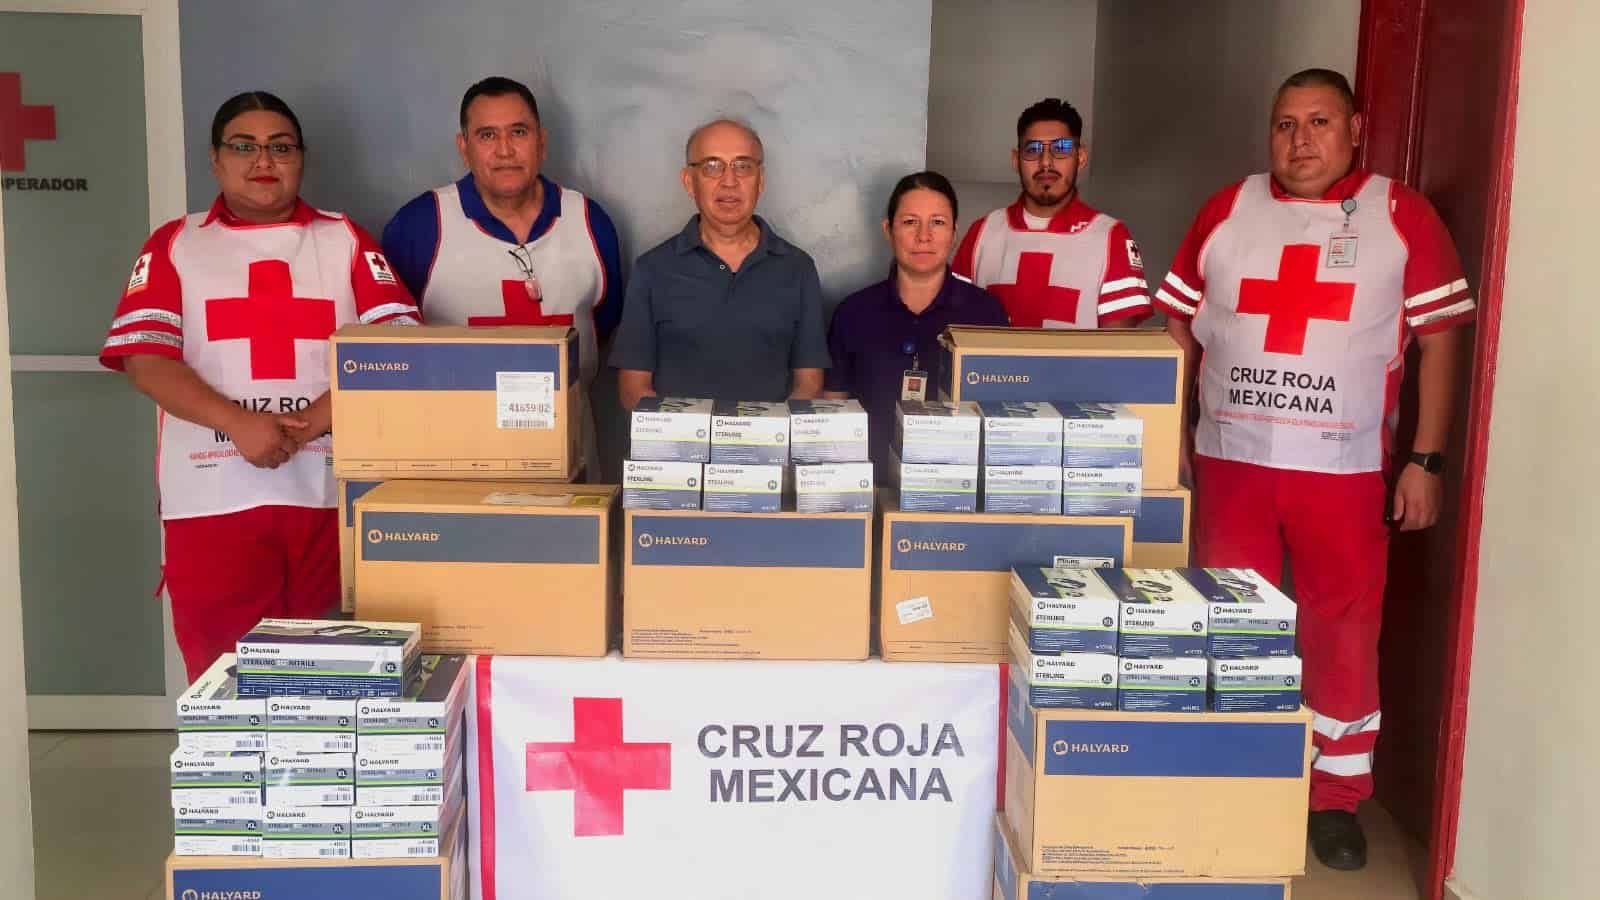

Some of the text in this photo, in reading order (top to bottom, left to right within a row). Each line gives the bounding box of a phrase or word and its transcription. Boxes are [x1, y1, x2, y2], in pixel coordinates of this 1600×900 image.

[359, 362, 409, 371] HALYARD
[982, 374, 1030, 383] HALYARD
[1230, 366, 1336, 392] CRUZ ROJA
[1229, 388, 1334, 414] MEXICANA
[384, 532, 440, 542] HALYARD
[655, 536, 708, 546] HALYARD
[913, 542, 967, 552] HALYARD
[696, 722, 965, 758] CRUZ ROJA
[1071, 743, 1129, 753] HALYARD
[709, 767, 954, 803] MEXICANA
[201, 890, 261, 900] HALYARD
